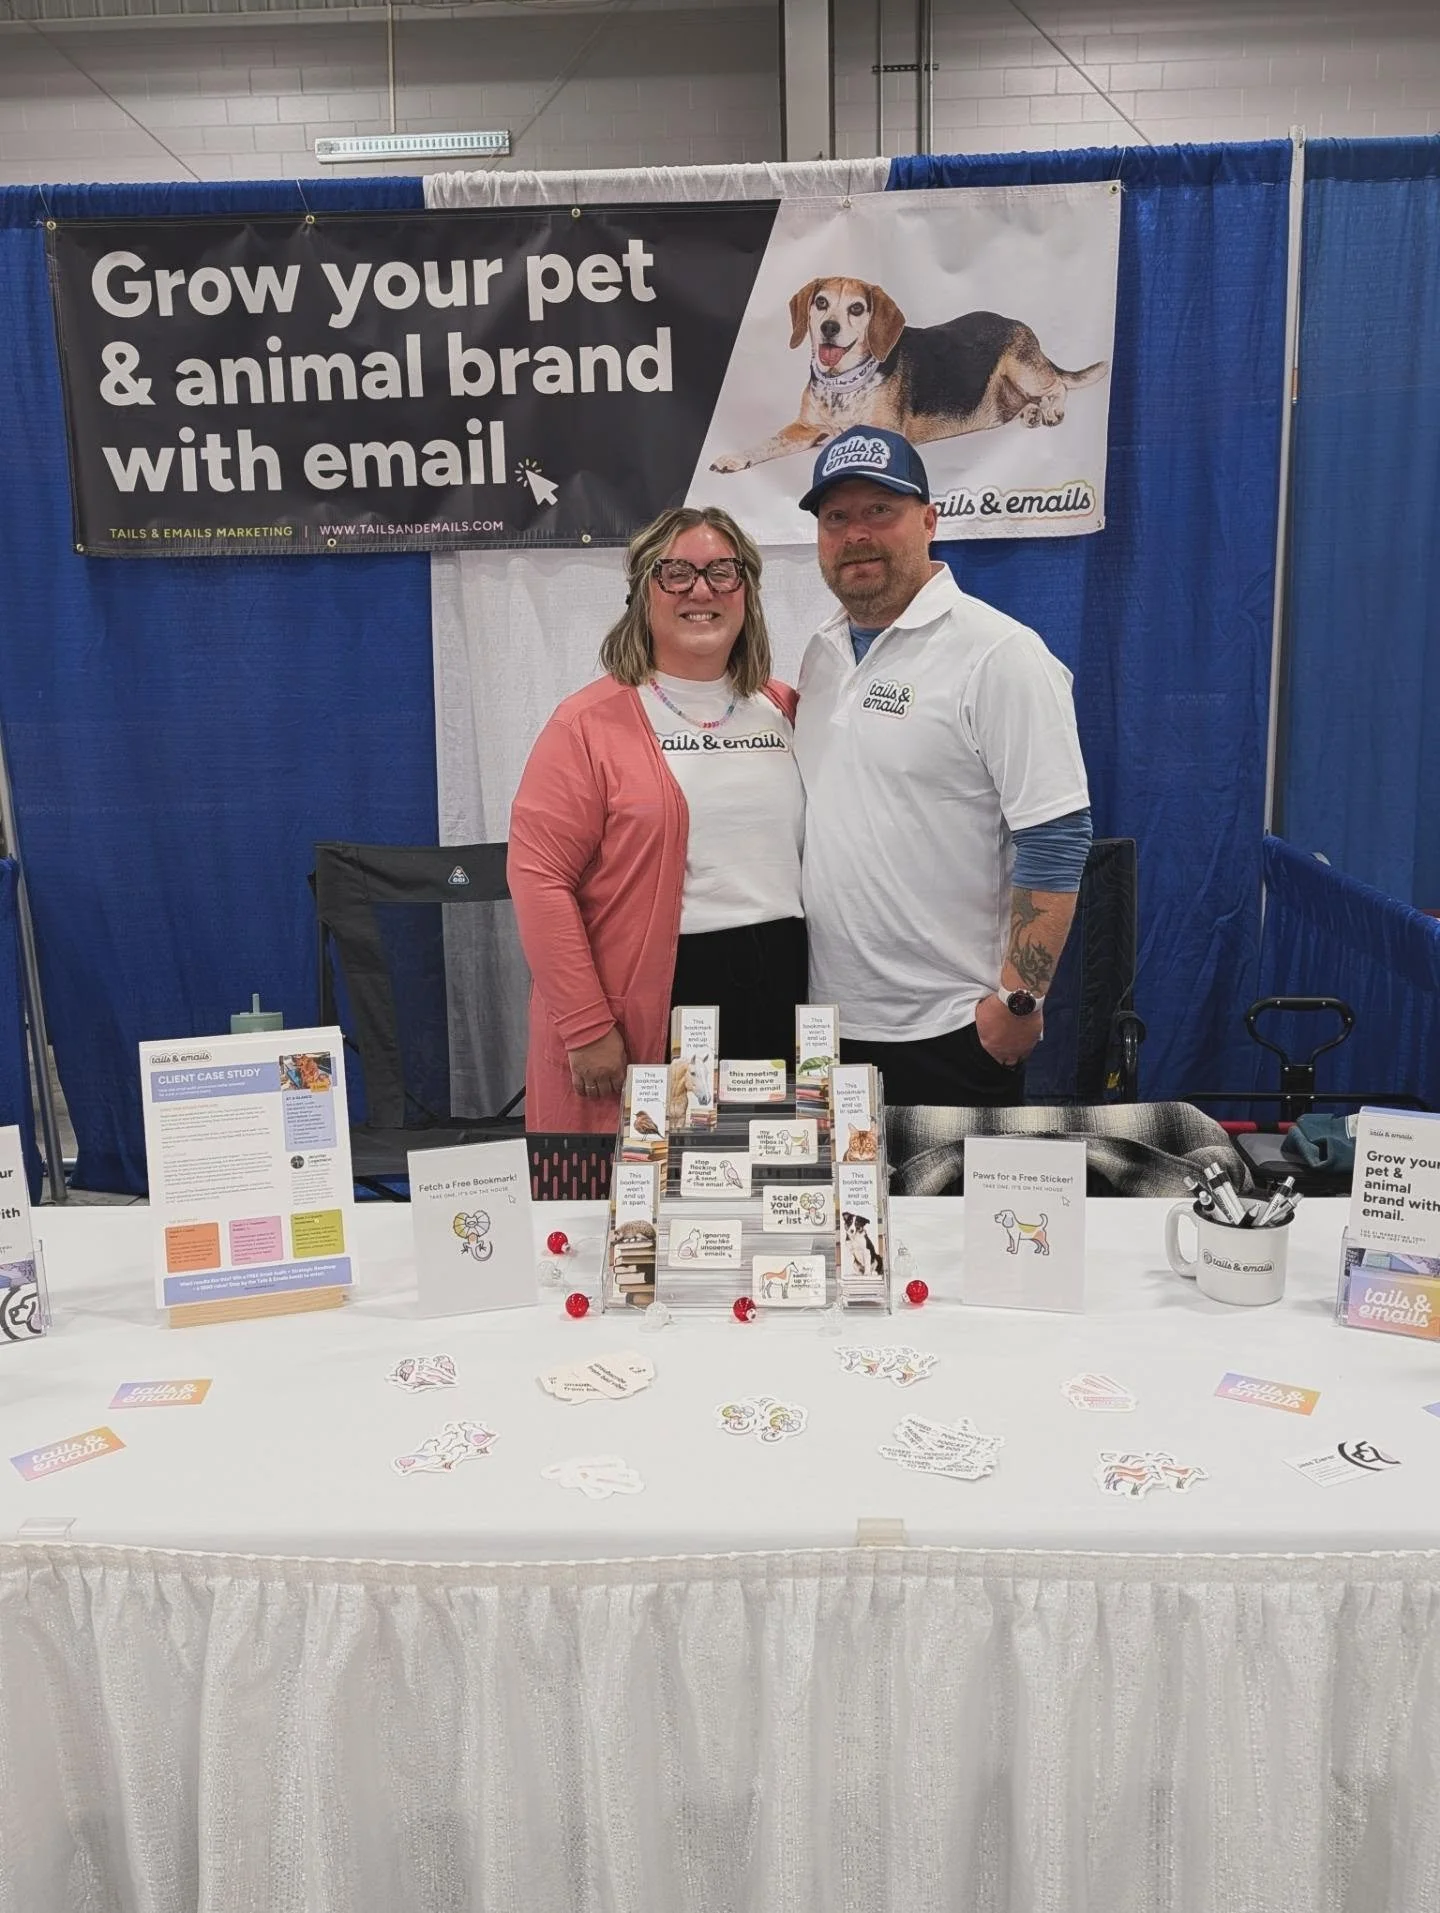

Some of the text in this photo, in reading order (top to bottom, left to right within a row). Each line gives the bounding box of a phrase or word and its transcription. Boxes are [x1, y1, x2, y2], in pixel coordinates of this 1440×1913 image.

[92, 239, 656, 329] Grow your pet
[100, 327, 673, 406] & animal brand
[102, 418, 507, 492] with email
[831, 438, 887, 458] tails &
[825, 450, 884, 473] emails
[935, 487, 1091, 518] ails & emails
[109, 526, 293, 539] TAILS & EMAILS MARKETING
[320, 520, 504, 536] WWW.TAILSANDEMAILS.COM
[869, 682, 910, 701] tails &
[862, 697, 907, 715] emails
[658, 734, 785, 751] ails & emails
[151, 1052, 210, 1064] tails & emails
[158, 1068, 261, 1085] CLIENT CASE STUDY
[1367, 1150, 1406, 1165] Grow
[0, 1168, 14, 1179] ur
[973, 1171, 995, 1180] Paws
[997, 1172, 1010, 1181] for
[1019, 1173, 1038, 1182] Free
[1040, 1174, 1074, 1184] Sticker!
[1365, 1166, 1403, 1179] pet &
[419, 1183, 443, 1192] Fetch
[452, 1180, 471, 1188] Free
[473, 1173, 517, 1186] Bookmark!
[1364, 1178, 1411, 1194] animal
[770, 1201, 793, 1210] your
[772, 1194, 798, 1202] scale
[1363, 1192, 1440, 1212] brand with
[0, 1207, 21, 1219] ith
[786, 1216, 802, 1225] list
[1362, 1208, 1404, 1221] email.
[1212, 1258, 1273, 1273] tails & emails
[1364, 1287, 1432, 1313] tails &
[1359, 1304, 1429, 1328] emails
[131, 1383, 198, 1395] tails &
[32, 1435, 106, 1463] tails &
[33, 1442, 109, 1472] emails
